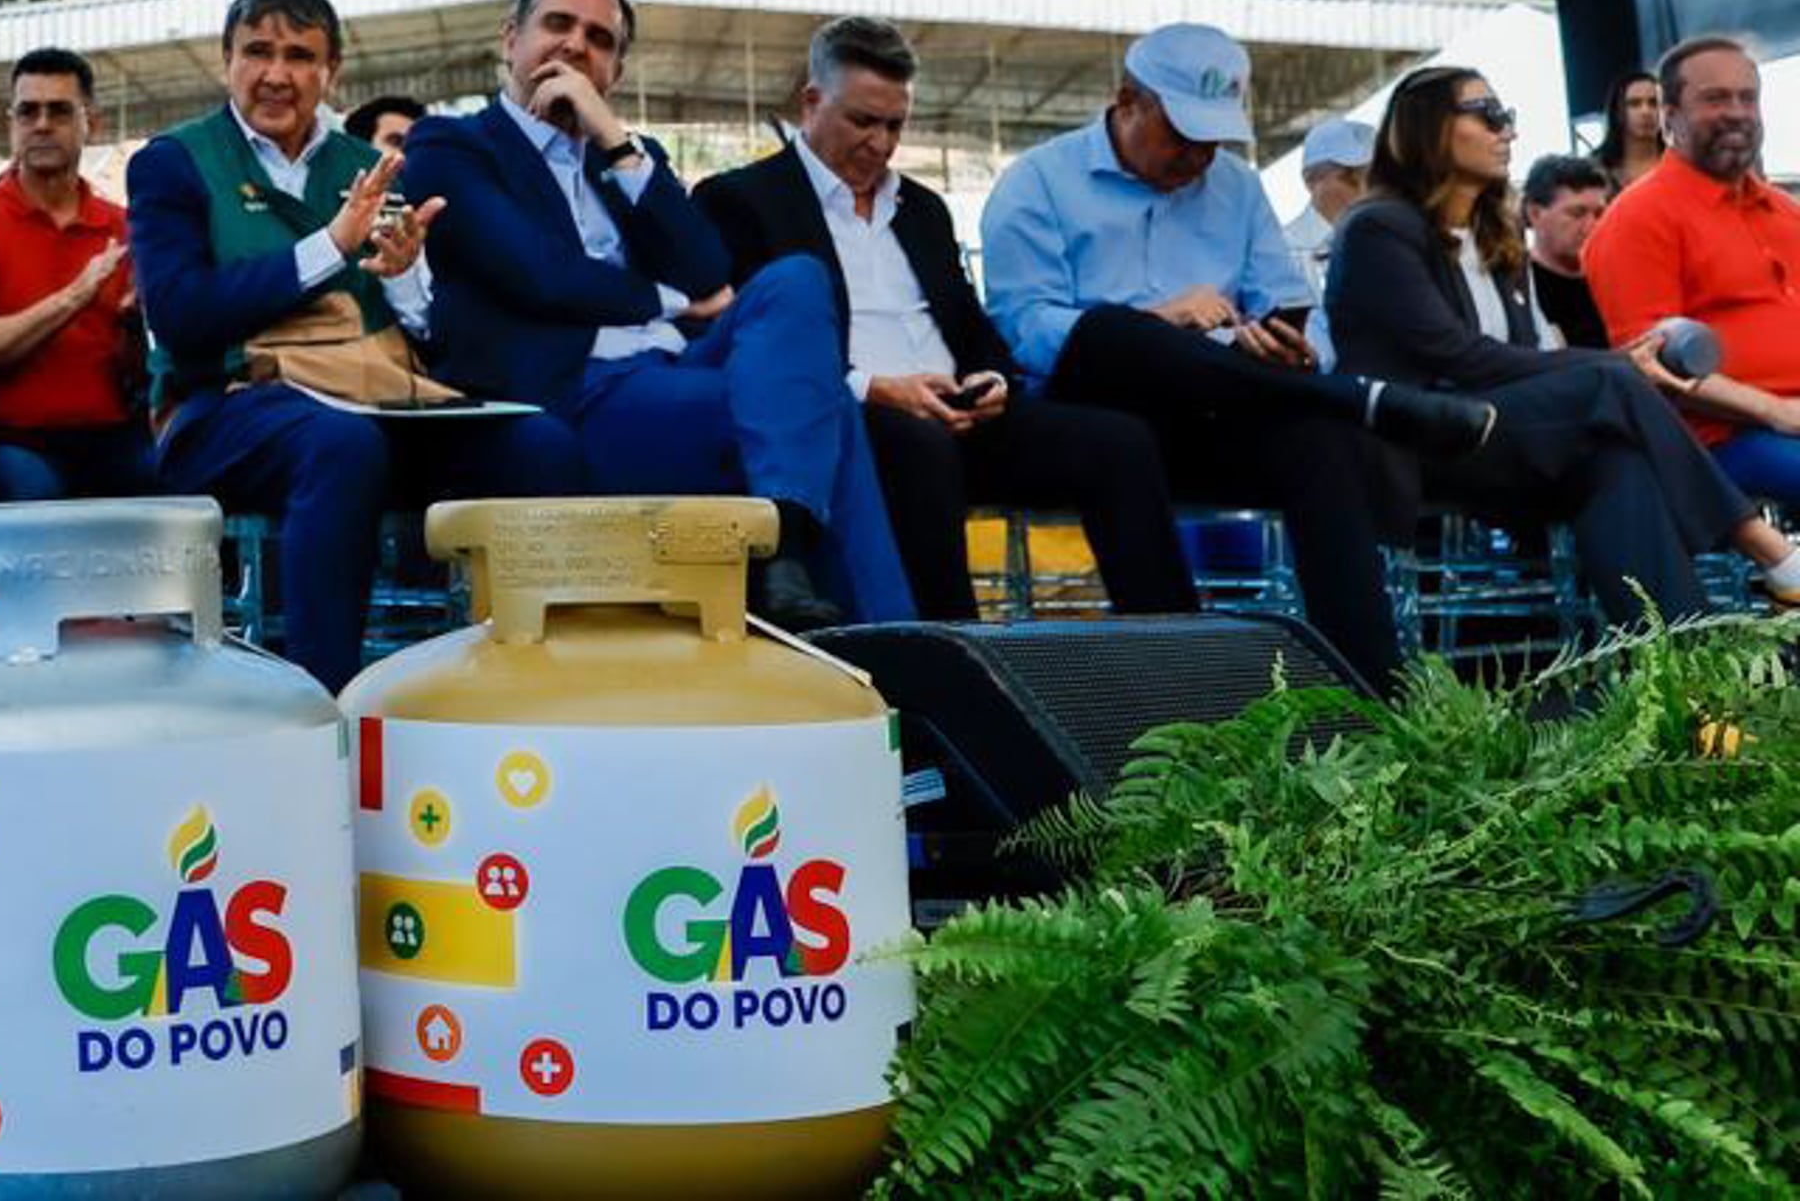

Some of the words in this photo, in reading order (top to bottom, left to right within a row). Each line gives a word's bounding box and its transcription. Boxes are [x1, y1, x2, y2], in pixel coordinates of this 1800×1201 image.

[646, 990, 720, 1031] DO
[733, 983, 846, 1029] POVO
[77, 1027, 156, 1073] DO
[169, 1010, 288, 1066] POVO
